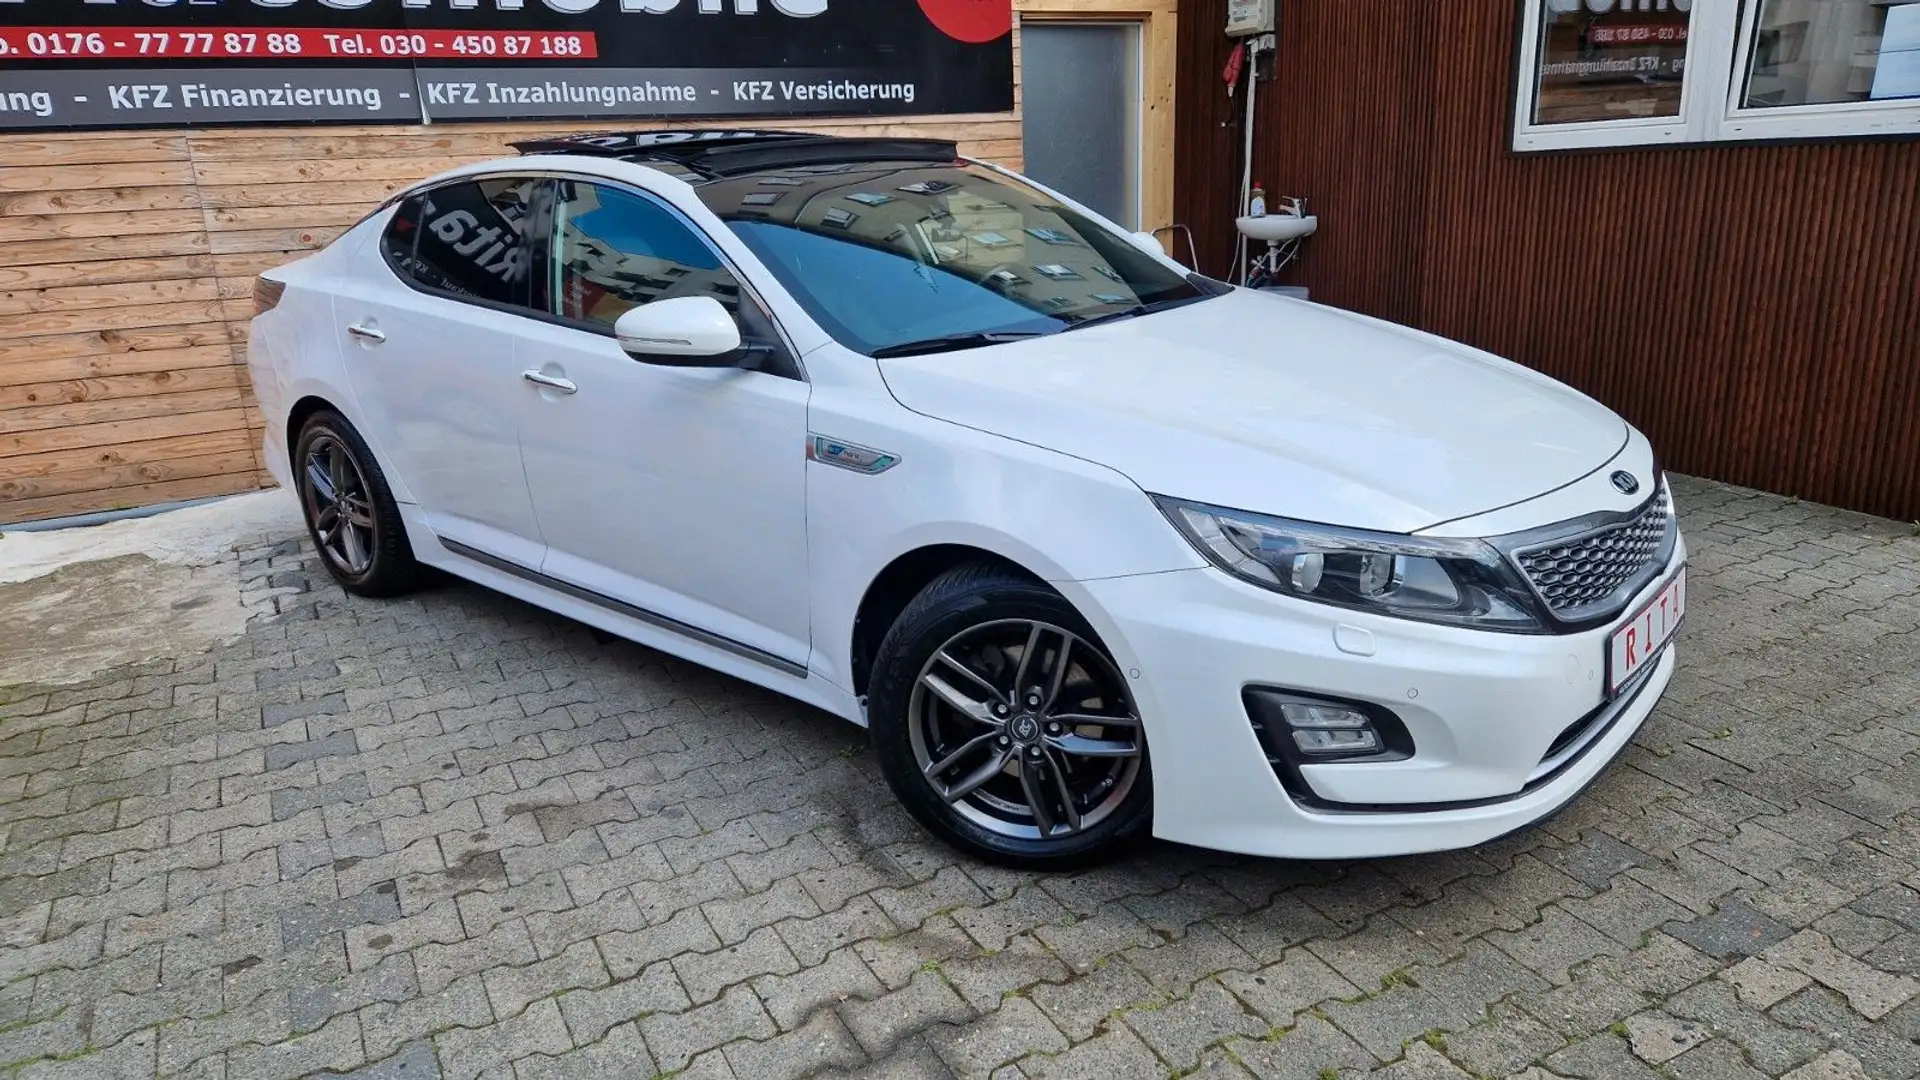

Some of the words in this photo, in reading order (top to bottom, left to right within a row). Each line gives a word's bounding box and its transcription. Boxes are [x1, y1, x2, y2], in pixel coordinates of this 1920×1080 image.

[27, 33, 105, 54] 0176
[134, 33, 170, 54] 77
[180, 33, 215, 53] 77
[223, 33, 258, 53] 87
[267, 33, 302, 53] 88
[323, 34, 372, 54] Tel.
[380, 34, 426, 55] 030
[451, 35, 497, 55] 450
[504, 36, 531, 55] 87
[541, 37, 582, 55] 188
[108, 85, 172, 109] KFZ
[180, 83, 382, 111] Finanzierung
[427, 83, 480, 105] KFZ
[487, 81, 696, 107] Inzahlungnahme
[733, 81, 773, 101] KFZ
[780, 79, 915, 103] Versicherung
